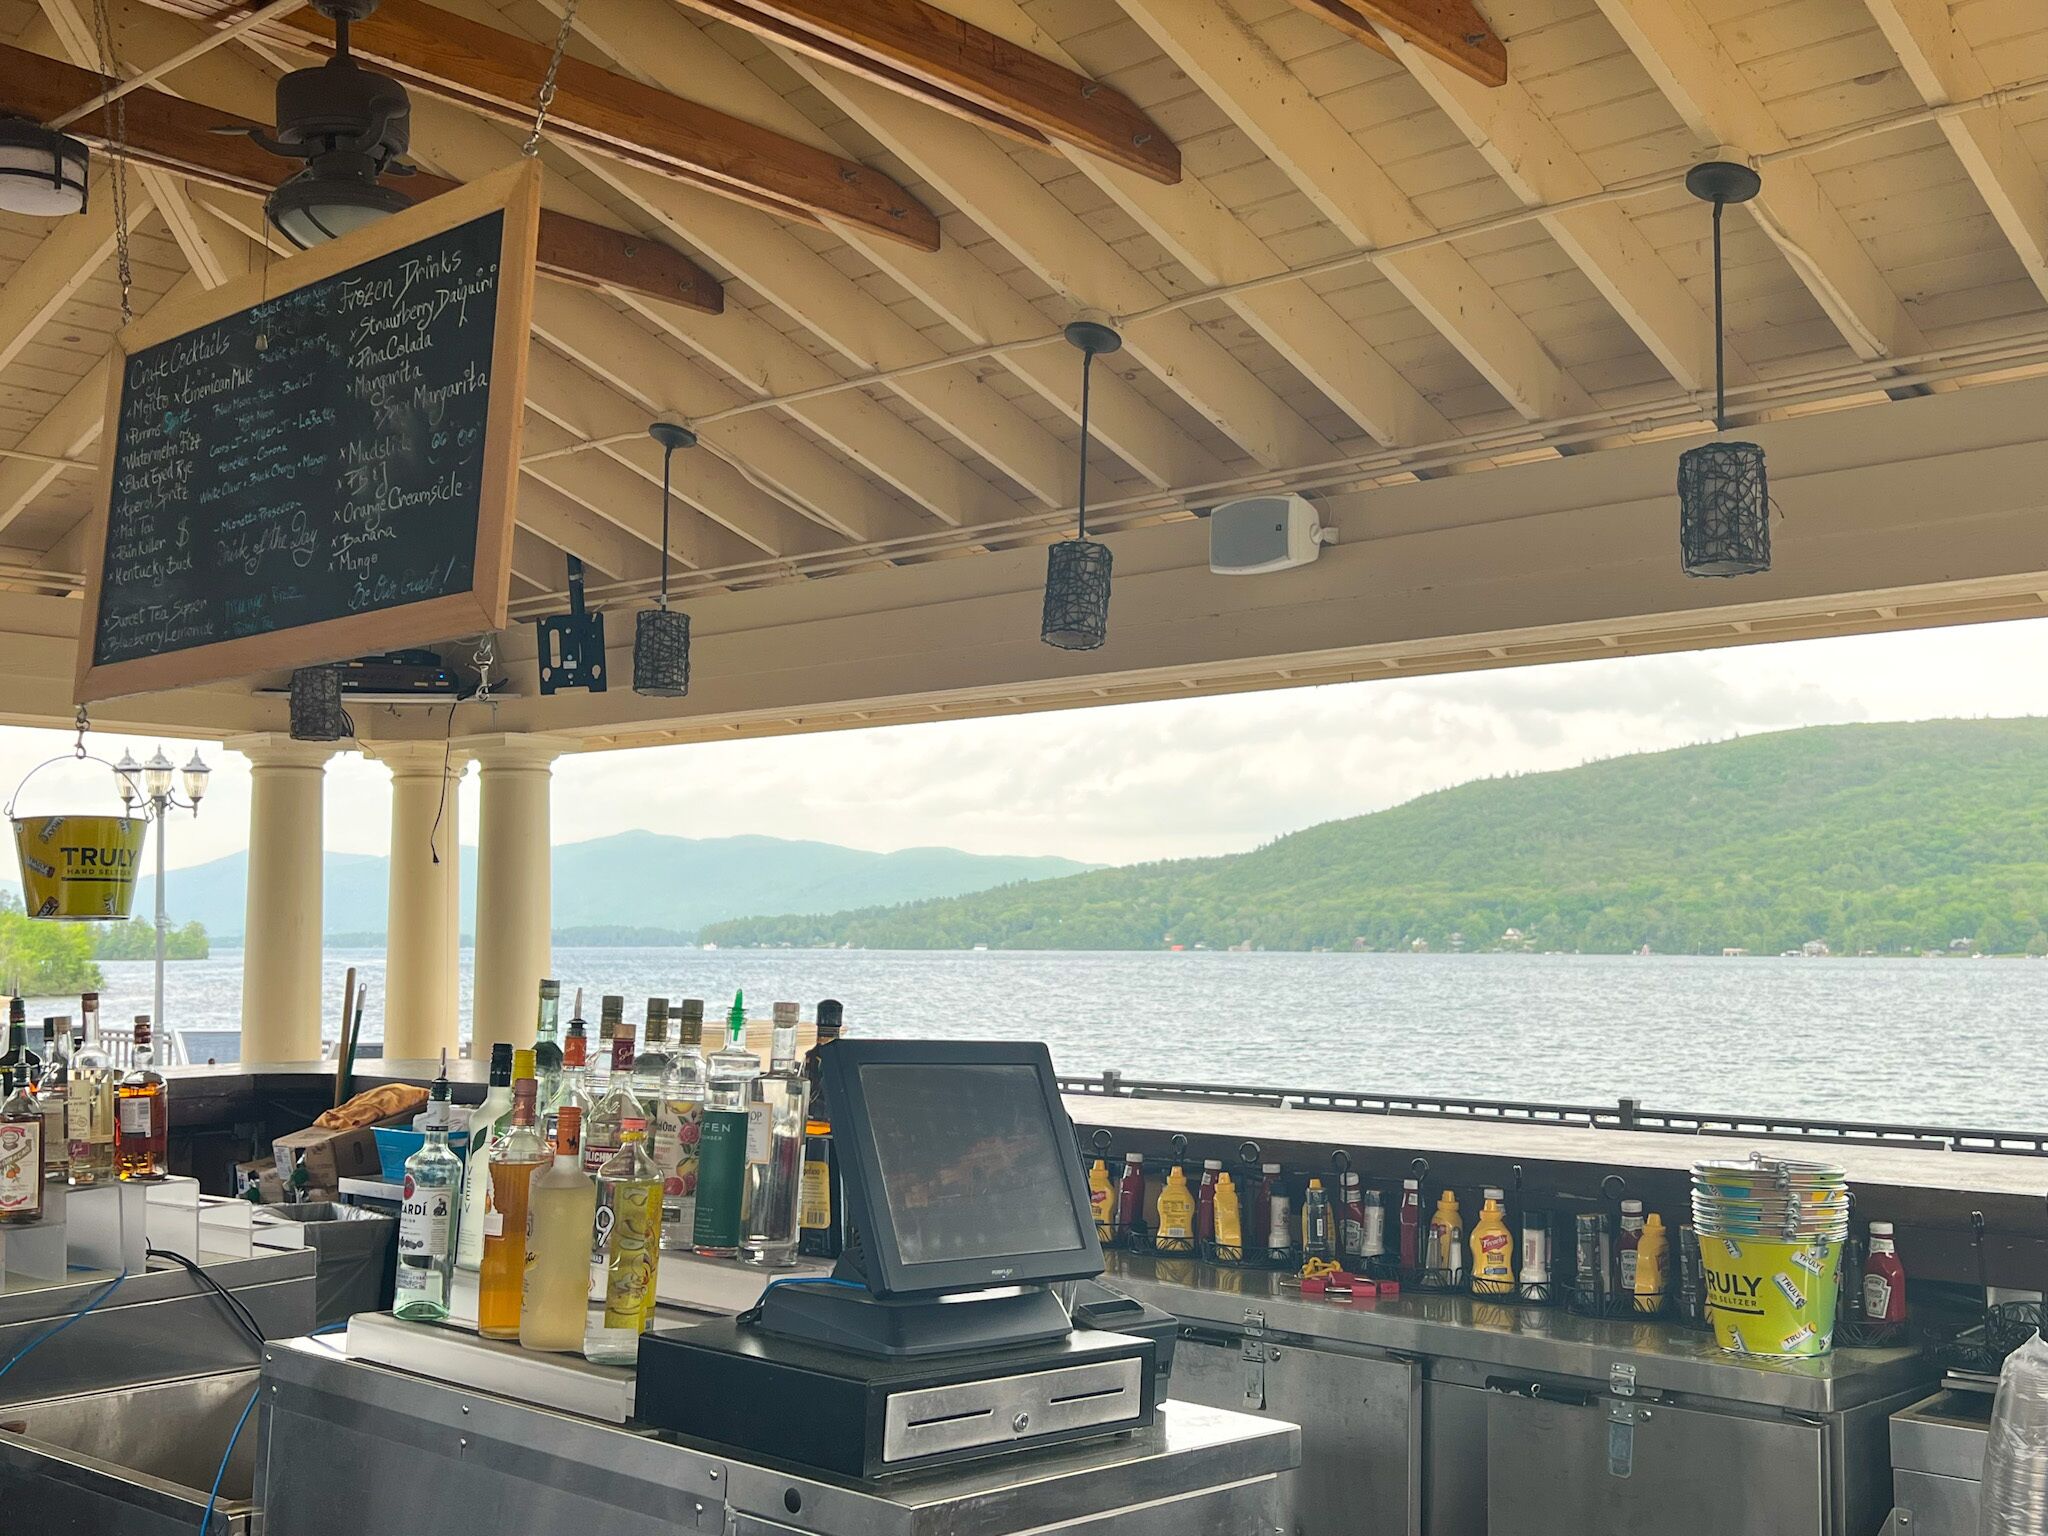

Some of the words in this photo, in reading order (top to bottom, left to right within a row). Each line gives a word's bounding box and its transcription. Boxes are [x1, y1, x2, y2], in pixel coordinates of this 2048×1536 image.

[337, 277, 393, 314] Frozen
[392, 250, 462, 311] Drinks
[354, 300, 435, 348] Strawberry
[432, 264, 497, 328] Daiquiri
[171, 329, 230, 374] Cocktails
[386, 329, 434, 360] Colada
[354, 359, 423, 407] Margarita
[413, 361, 488, 426] Margarita
[343, 501, 386, 531] Orange
[388, 470, 463, 511] Creamsicle
[333, 526, 397, 557] Banana
[115, 558, 164, 588] Kentucky
[339, 551, 378, 580] Mango
[60, 847, 137, 867] TRULY
[1798, 1252, 1821, 1270] TRULY
[1706, 1269, 1763, 1298] RULY
[1781, 1275, 1801, 1300] TRULY
[1719, 1295, 1757, 1307] SELTZER
[1784, 1327, 1809, 1345] TRULY
